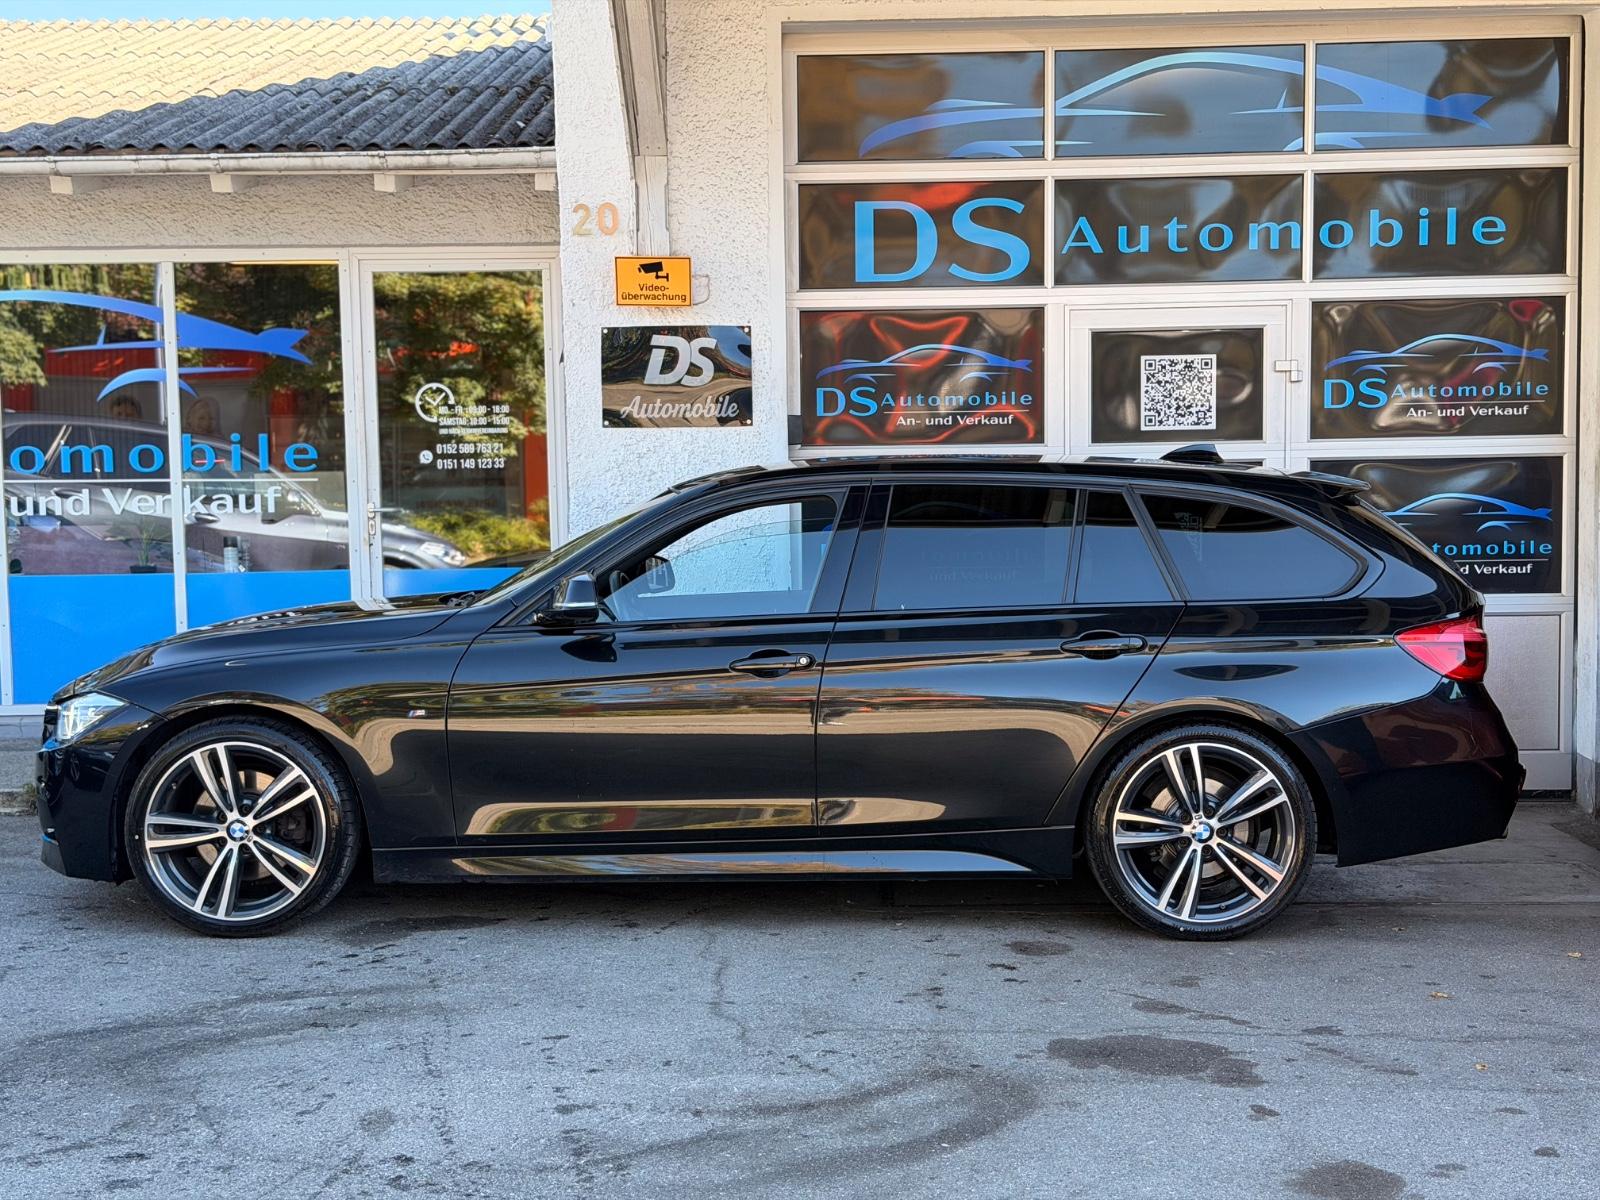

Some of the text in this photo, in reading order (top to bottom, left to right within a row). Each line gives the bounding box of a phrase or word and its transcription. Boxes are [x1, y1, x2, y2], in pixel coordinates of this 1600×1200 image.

[572, 202, 619, 235] 20
[854, 197, 1507, 282] DS Automobile
[638, 283, 670, 292] Video-
[621, 292, 687, 303] überwachung
[643, 334, 717, 387] DS
[815, 386, 1033, 417] DS Automobile
[1323, 378, 1549, 409] DS Automobile
[621, 395, 740, 418] Automobile
[1406, 405, 1529, 417] An- und Verkauf
[896, 414, 1014, 426] An- und Verkauf
[436, 443, 457, 454] 0152
[493, 443, 503, 453] 21
[437, 458, 504, 469] 0151 149 123 33
[10, 485, 282, 516] und Verkauf
[1474, 563, 1533, 574] Verkauf
